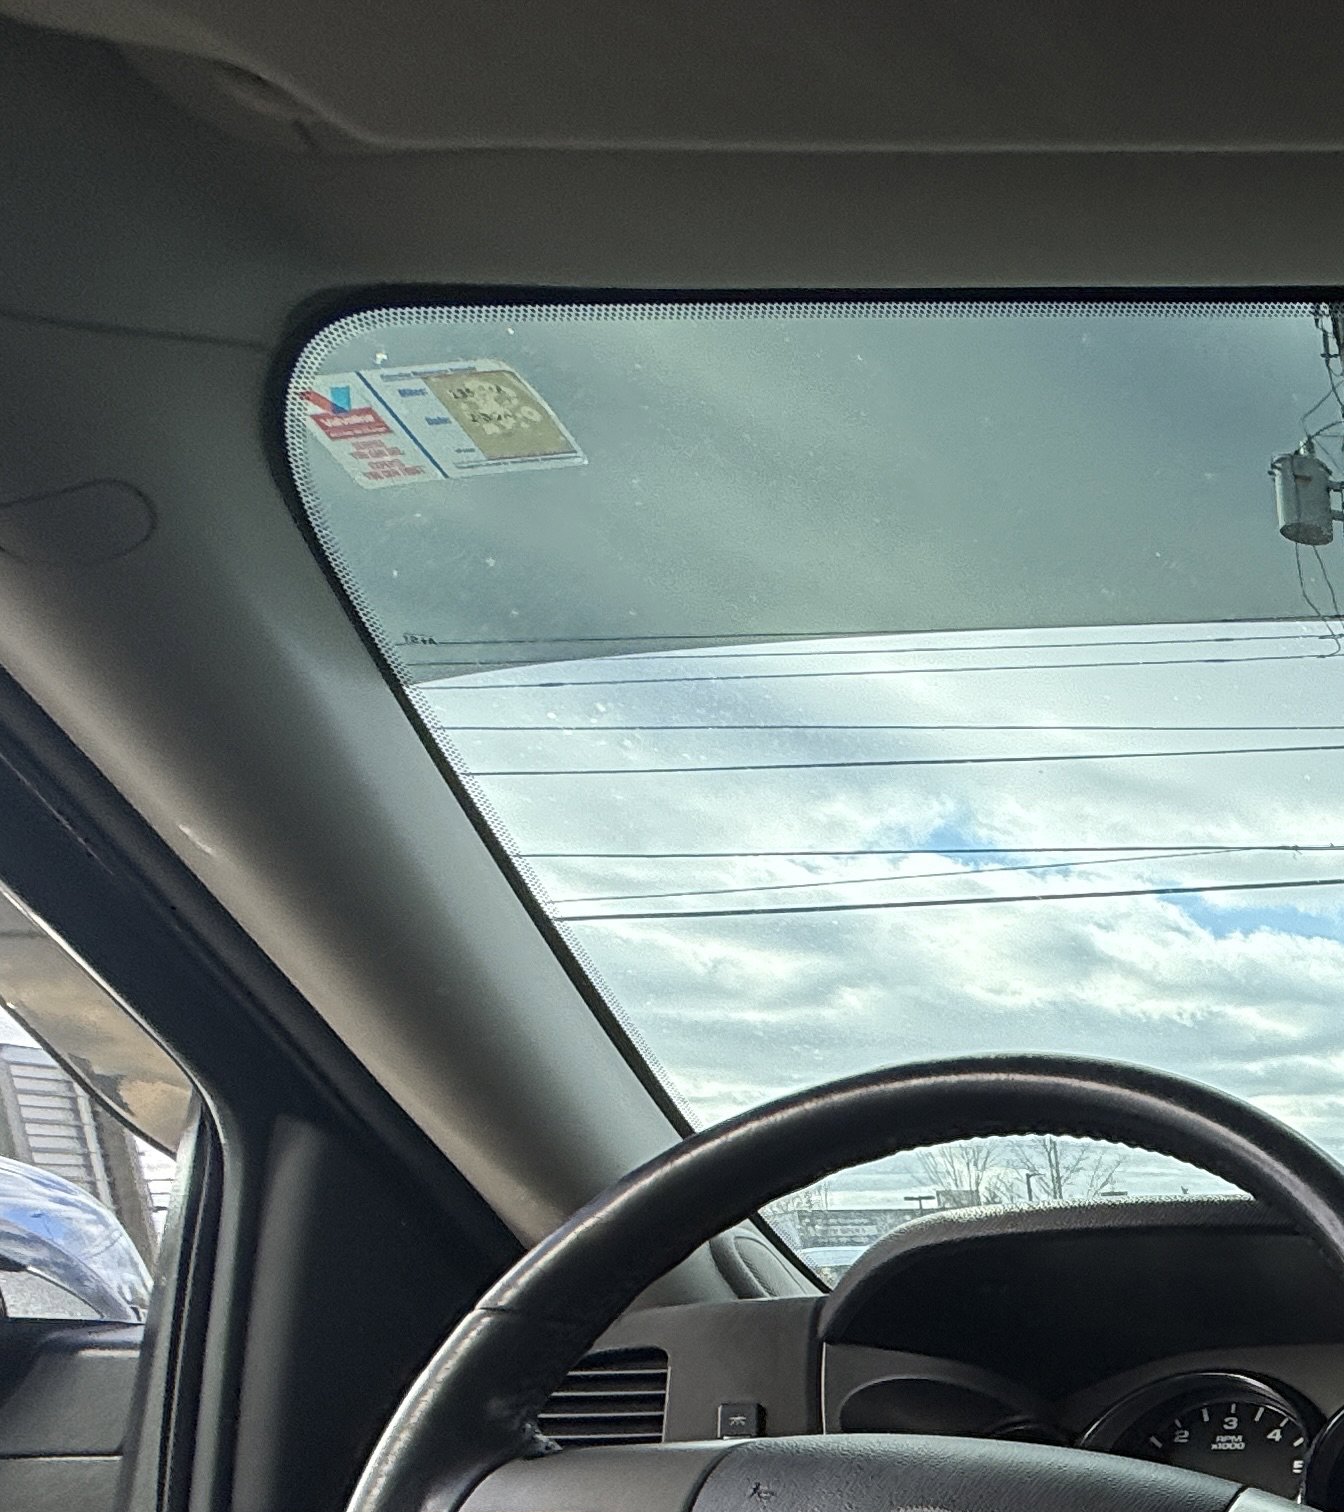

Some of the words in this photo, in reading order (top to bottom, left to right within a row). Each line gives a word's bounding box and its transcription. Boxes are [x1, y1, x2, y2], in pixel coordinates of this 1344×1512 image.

[1223, 1416, 1238, 1430] 3
[1174, 1429, 1189, 1444] 2
[1215, 1434, 1243, 1444] RPM
[1267, 1429, 1283, 1442] 4
